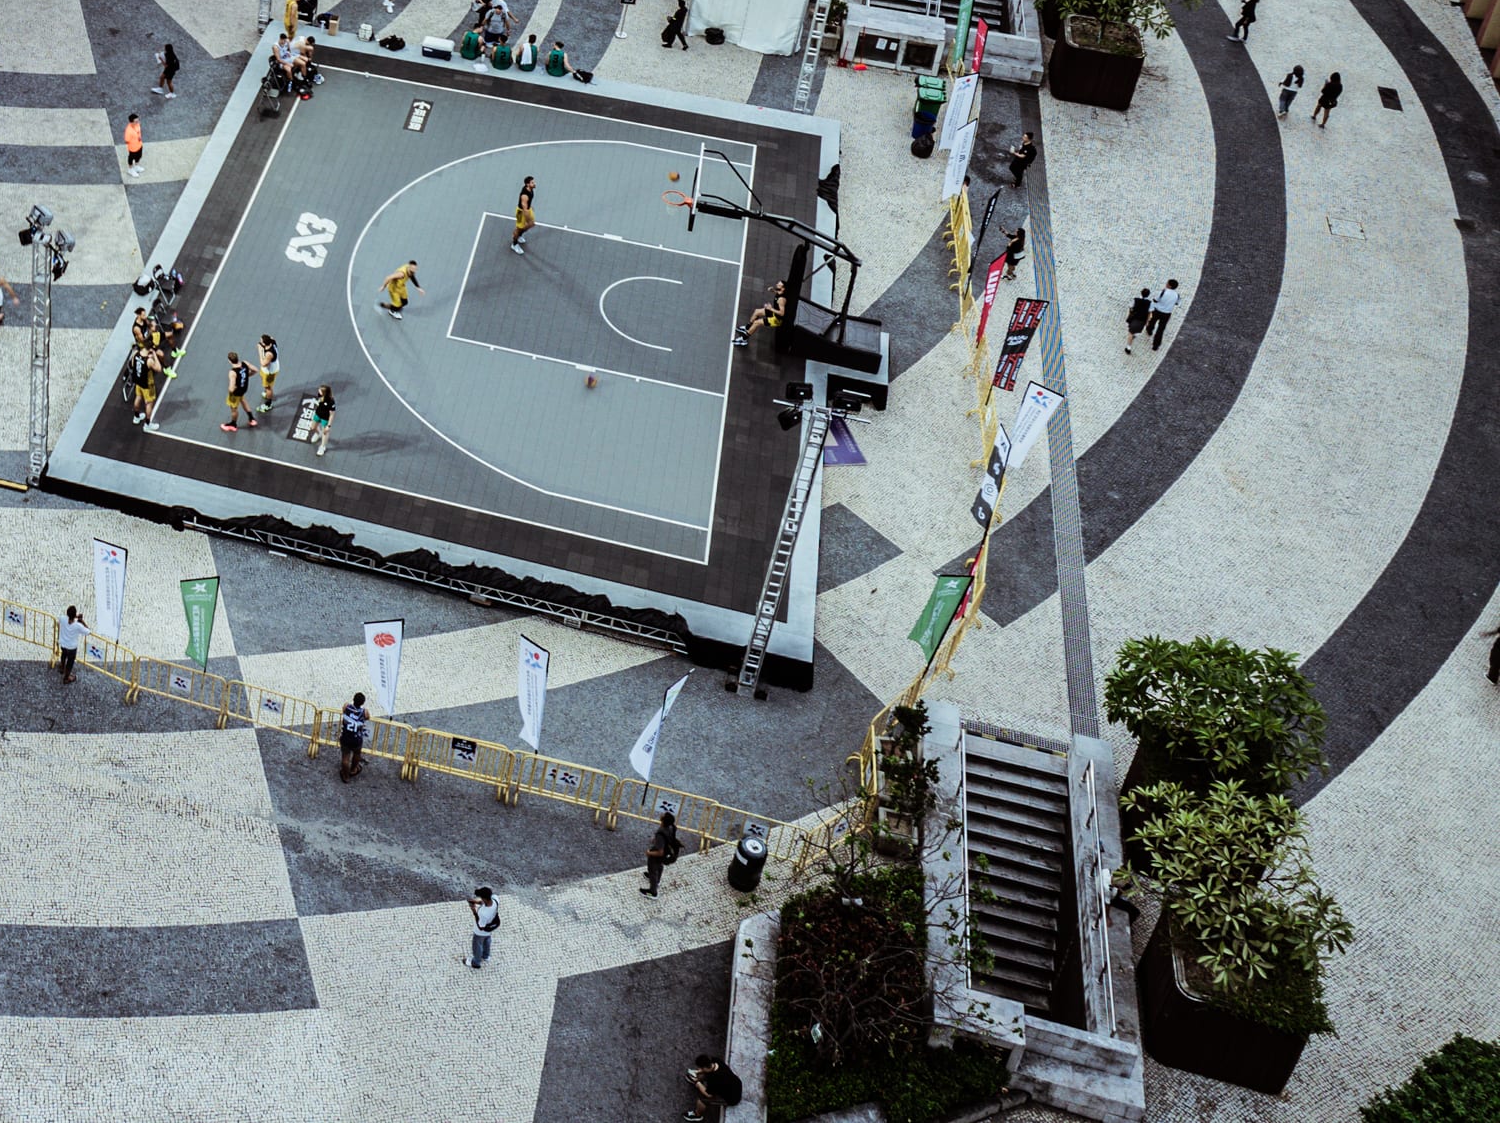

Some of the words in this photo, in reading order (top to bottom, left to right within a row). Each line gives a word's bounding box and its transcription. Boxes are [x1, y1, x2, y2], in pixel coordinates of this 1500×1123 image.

[467, 36, 473, 47] 1
[500, 51, 507, 60] 2
[552, 54, 559, 64] 3
[346, 720, 358, 733] 21
